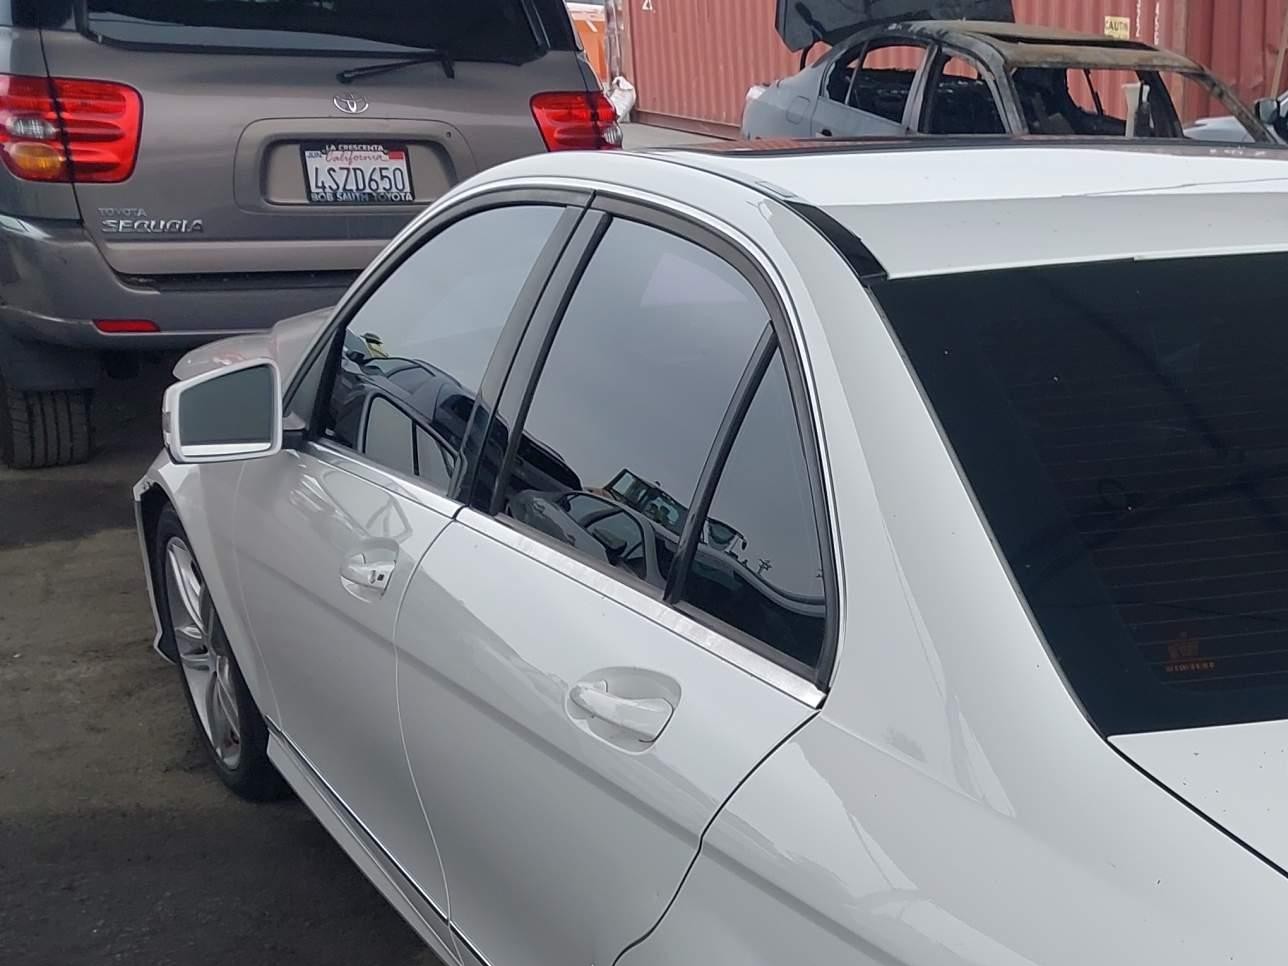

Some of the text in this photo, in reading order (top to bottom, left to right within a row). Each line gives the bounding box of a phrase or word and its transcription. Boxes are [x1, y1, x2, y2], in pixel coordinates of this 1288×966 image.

[314, 167, 405, 193] 4SZD650
[311, 192, 334, 201] BOB
[370, 192, 414, 201] TOYOTA
[98, 207, 147, 217] TOYOTA
[102, 219, 204, 233] SEQUOIA
